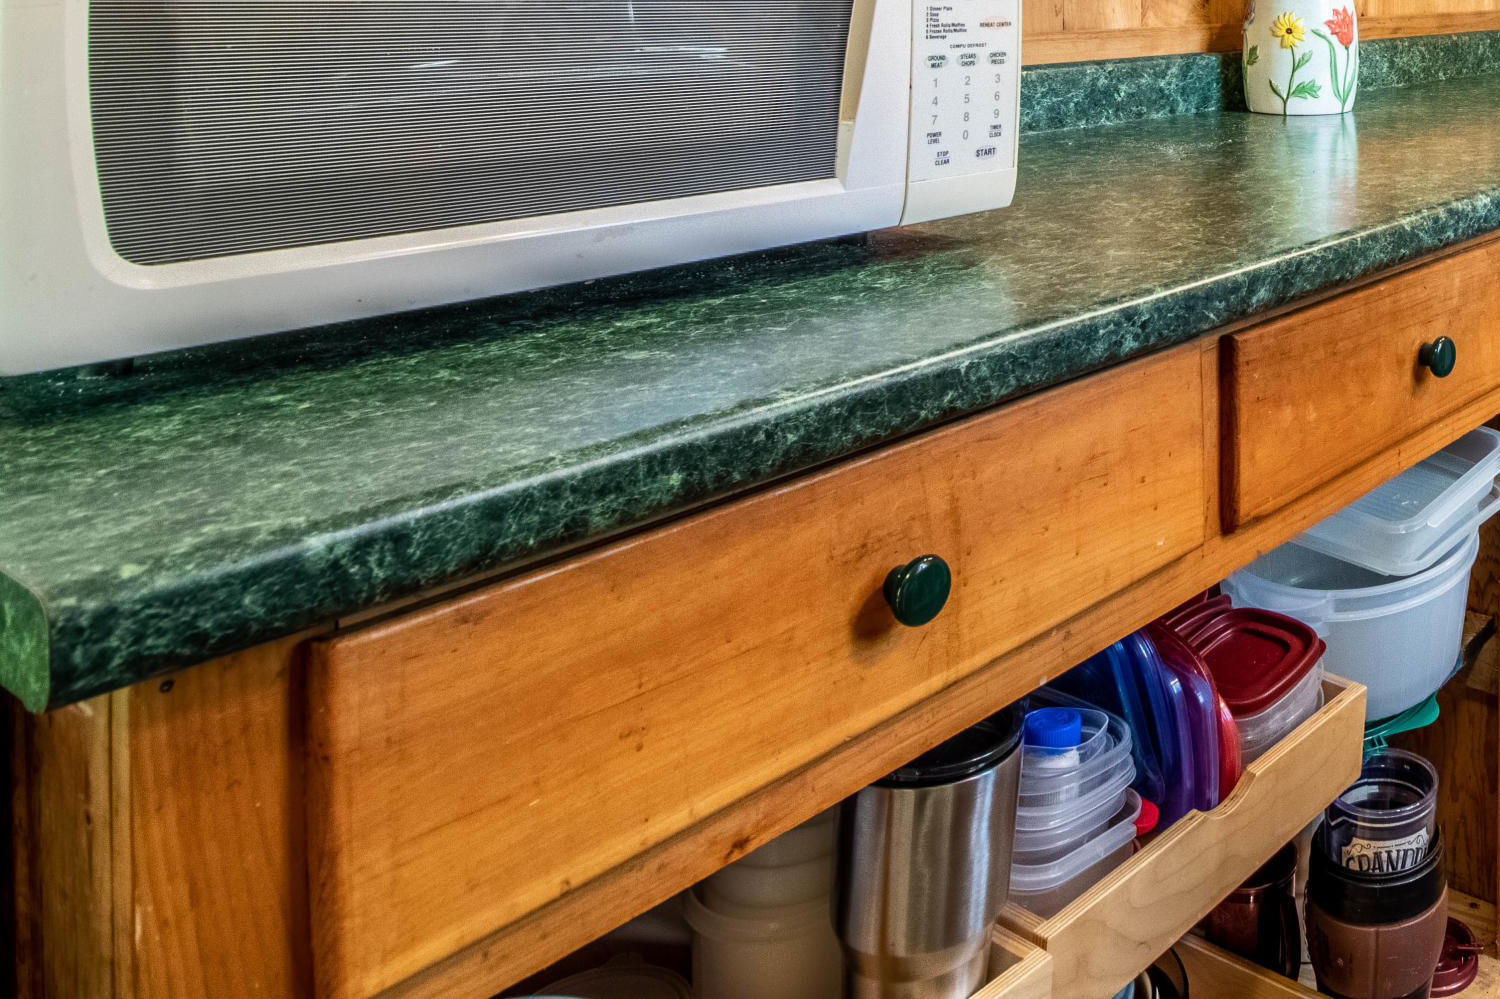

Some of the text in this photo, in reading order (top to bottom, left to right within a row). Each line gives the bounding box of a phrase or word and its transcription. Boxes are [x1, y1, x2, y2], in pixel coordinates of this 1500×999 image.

[933, 73, 1001, 88] 1 2 3
[932, 91, 1000, 106] 4 5 6
[931, 108, 1000, 125] 7 8 9
[962, 130, 969, 140] 0
[936, 150, 949, 158] STOP
[975, 147, 997, 158] START
[934, 158, 950, 166] CLEAR
